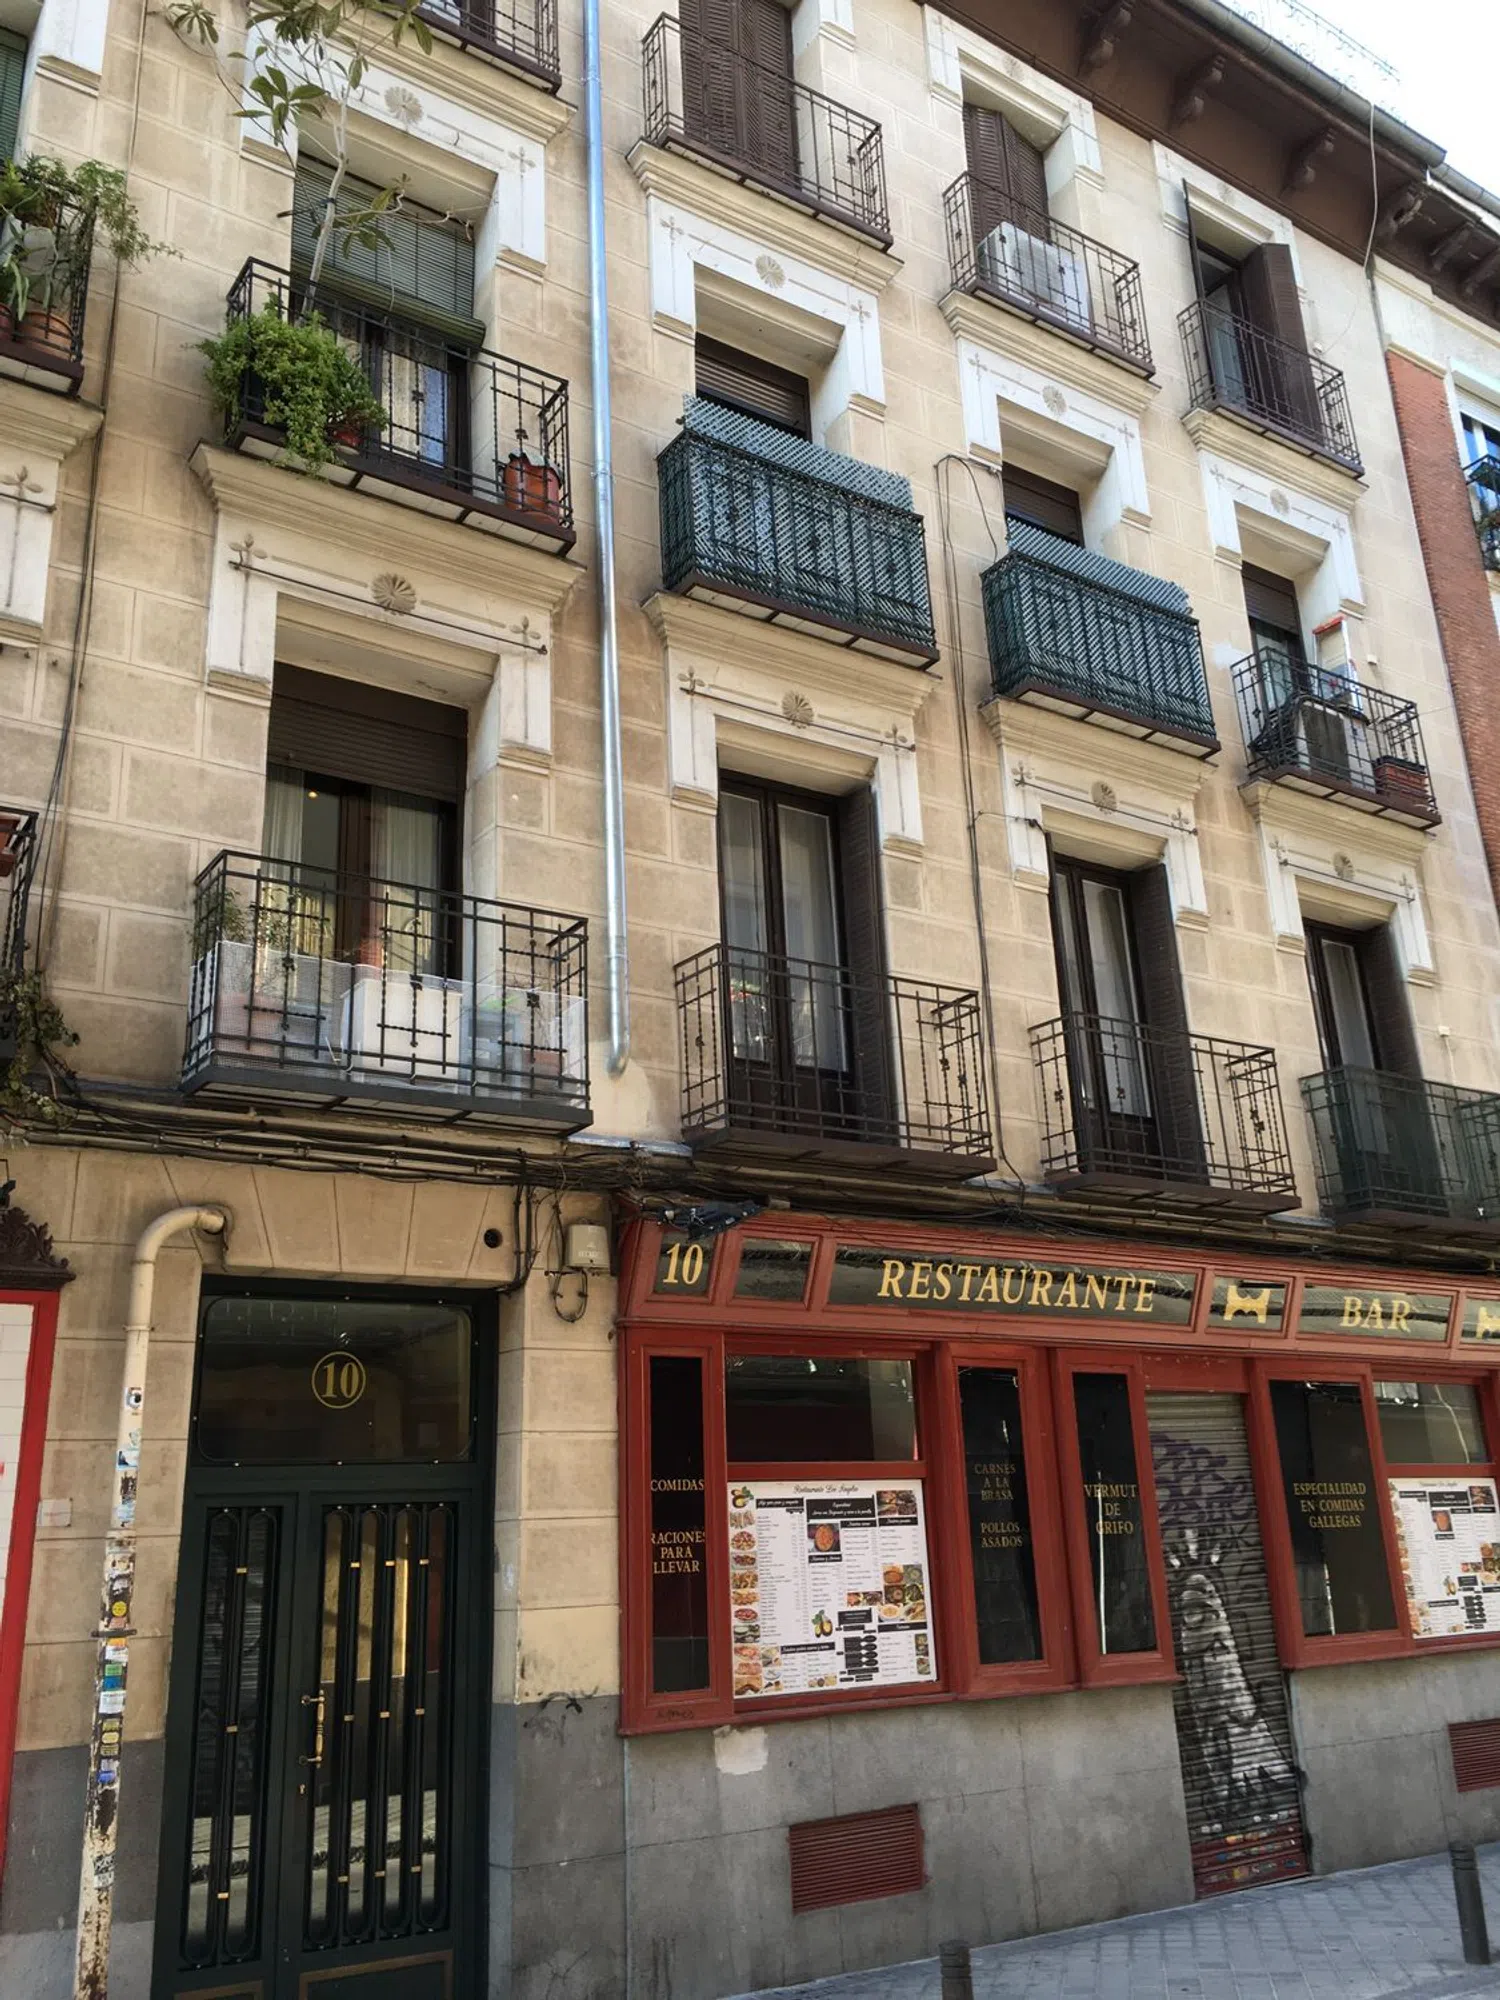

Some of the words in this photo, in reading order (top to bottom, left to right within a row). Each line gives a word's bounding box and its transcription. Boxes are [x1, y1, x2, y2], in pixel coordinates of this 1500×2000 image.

[662, 1240, 703, 1286] 10
[876, 1258, 1157, 1314] RESTAURANTE
[1341, 1294, 1412, 1332] BAR
[322, 1362, 359, 1399] 10
[974, 1463, 1016, 1474] CARNES
[651, 1479, 704, 1491] COMIDAS
[984, 1478, 991, 1488] A
[996, 1477, 1010, 1488] LA
[1294, 1482, 1367, 1496] ESPECIALIDAD
[981, 1489, 1014, 1501] BRASA
[1084, 1484, 1137, 1498] VERMUT
[1104, 1502, 1121, 1516] DE
[1301, 1500, 1315, 1513] EN
[1318, 1498, 1365, 1512] COMIDAS
[981, 1521, 1020, 1534] POLLOS
[1096, 1520, 1134, 1535] GRIFO
[1309, 1514, 1361, 1529] GALLEGAS
[981, 1536, 1023, 1548] ASADOS
[660, 1546, 693, 1559] PARA
[653, 1561, 700, 1574] LLEVAR
